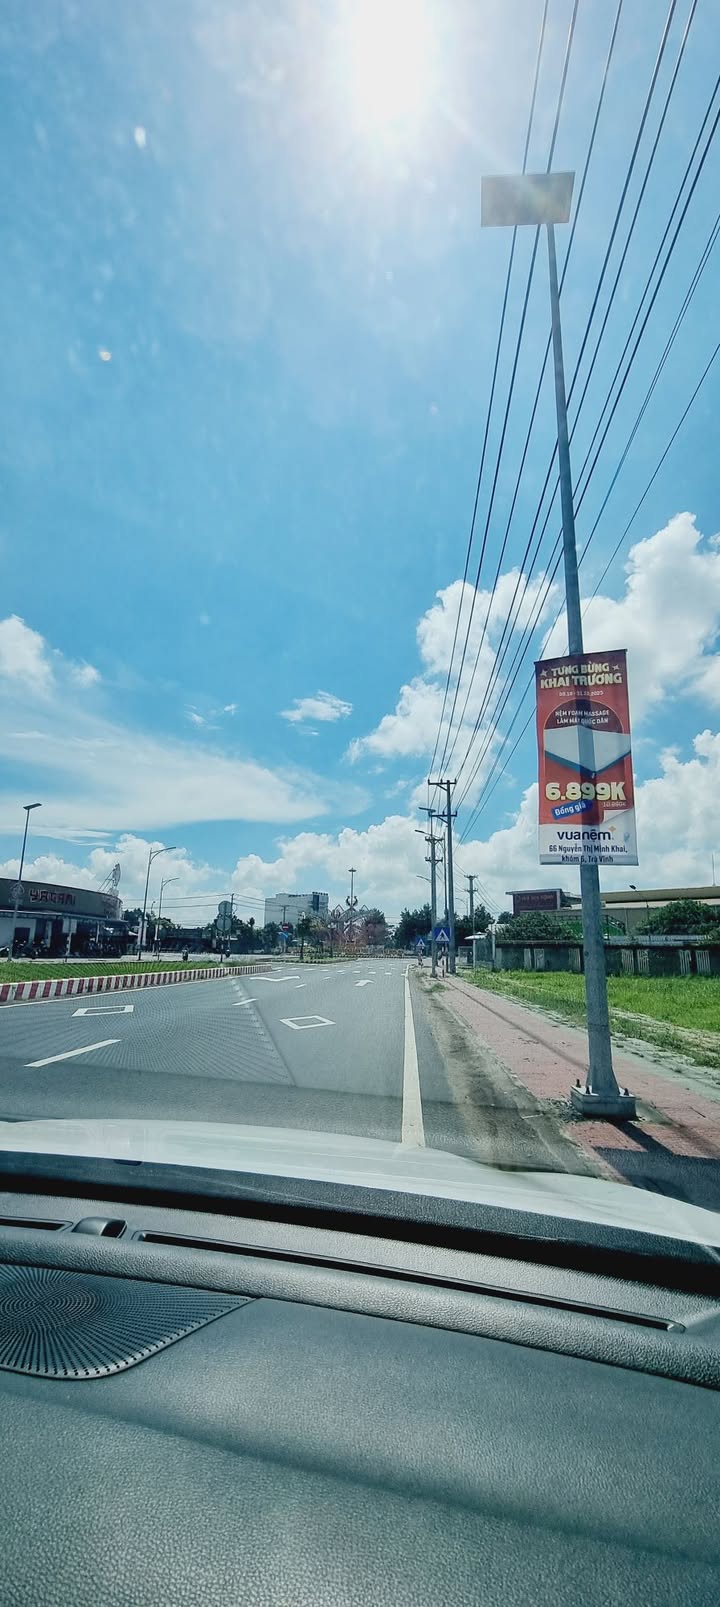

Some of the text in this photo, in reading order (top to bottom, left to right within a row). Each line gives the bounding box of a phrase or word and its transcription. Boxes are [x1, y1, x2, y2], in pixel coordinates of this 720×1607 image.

[540, 672, 623, 689] KHAI TRƯƠNG
[584, 709, 609, 717] MASSAGE
[545, 781, 626, 801] 6.899K
[574, 801, 586, 812] giá
[556, 829, 611, 842] vuanệm
[558, 843, 582, 853] Nguyễn
[583, 845, 593, 853] Thị
[593, 844, 610, 853] Minh
[611, 844, 628, 853] Khai,
